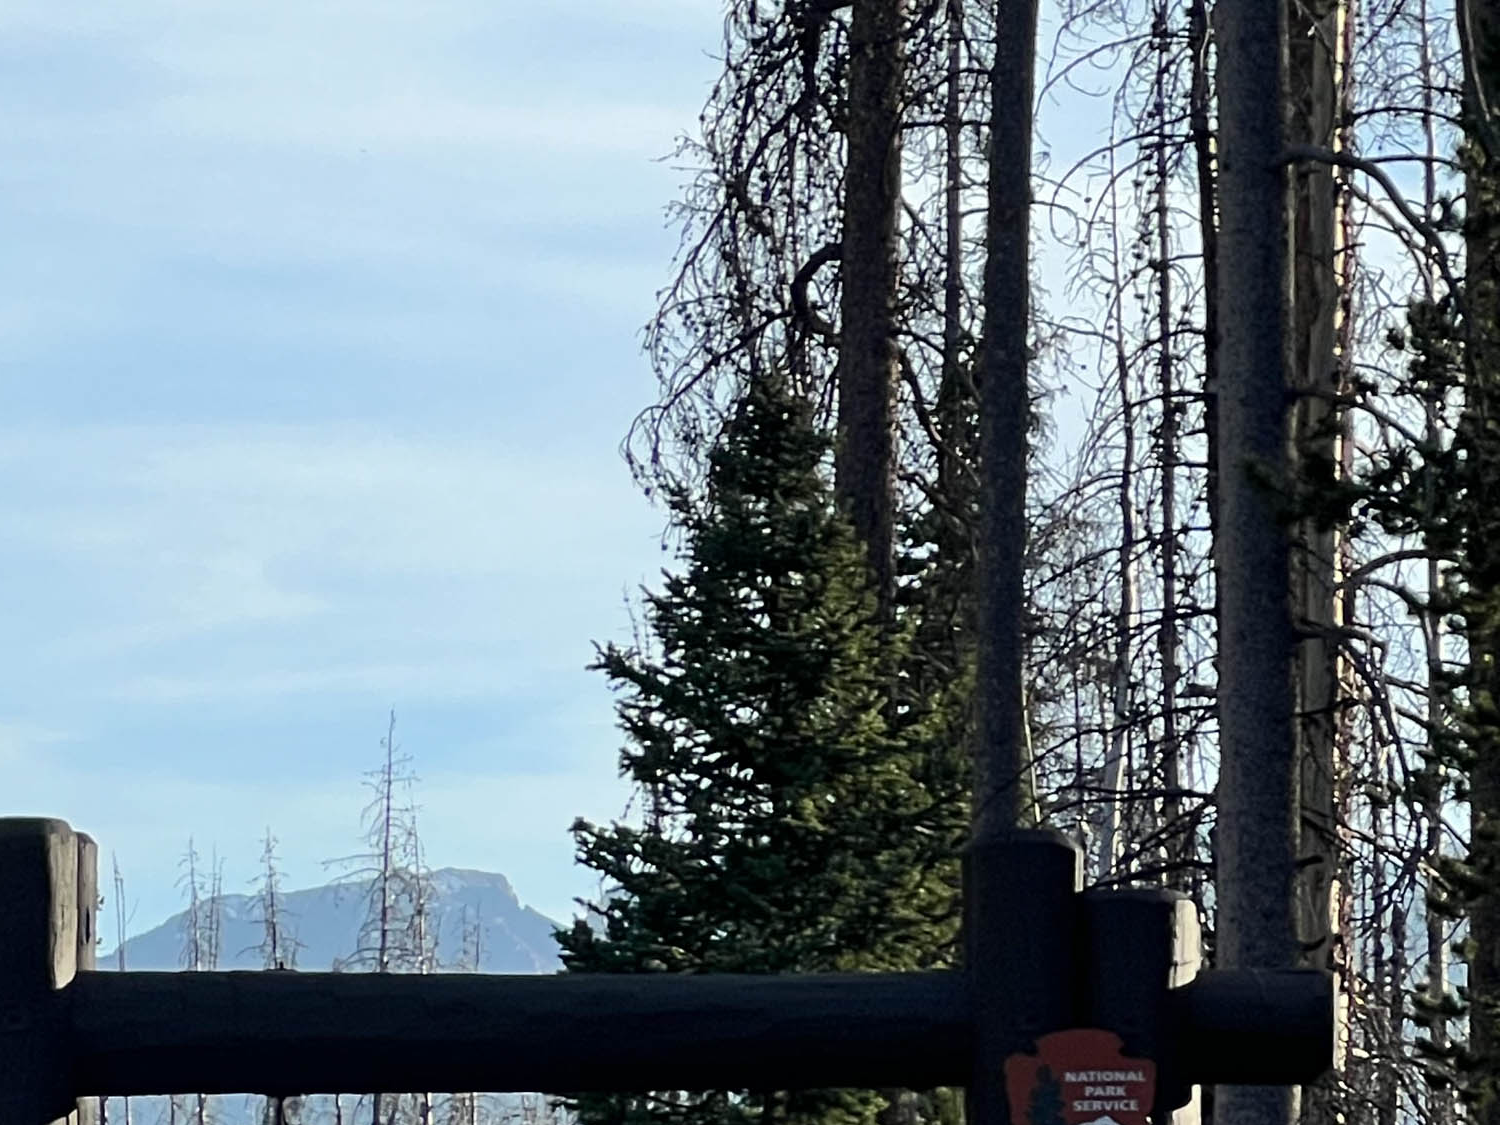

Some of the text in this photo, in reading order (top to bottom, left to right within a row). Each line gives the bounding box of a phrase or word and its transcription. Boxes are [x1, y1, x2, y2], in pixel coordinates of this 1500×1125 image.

[1064, 1070, 1146, 1082] NATIONAL
[1084, 1085, 1126, 1097] PARK
[1072, 1100, 1139, 1112] SERVICE
